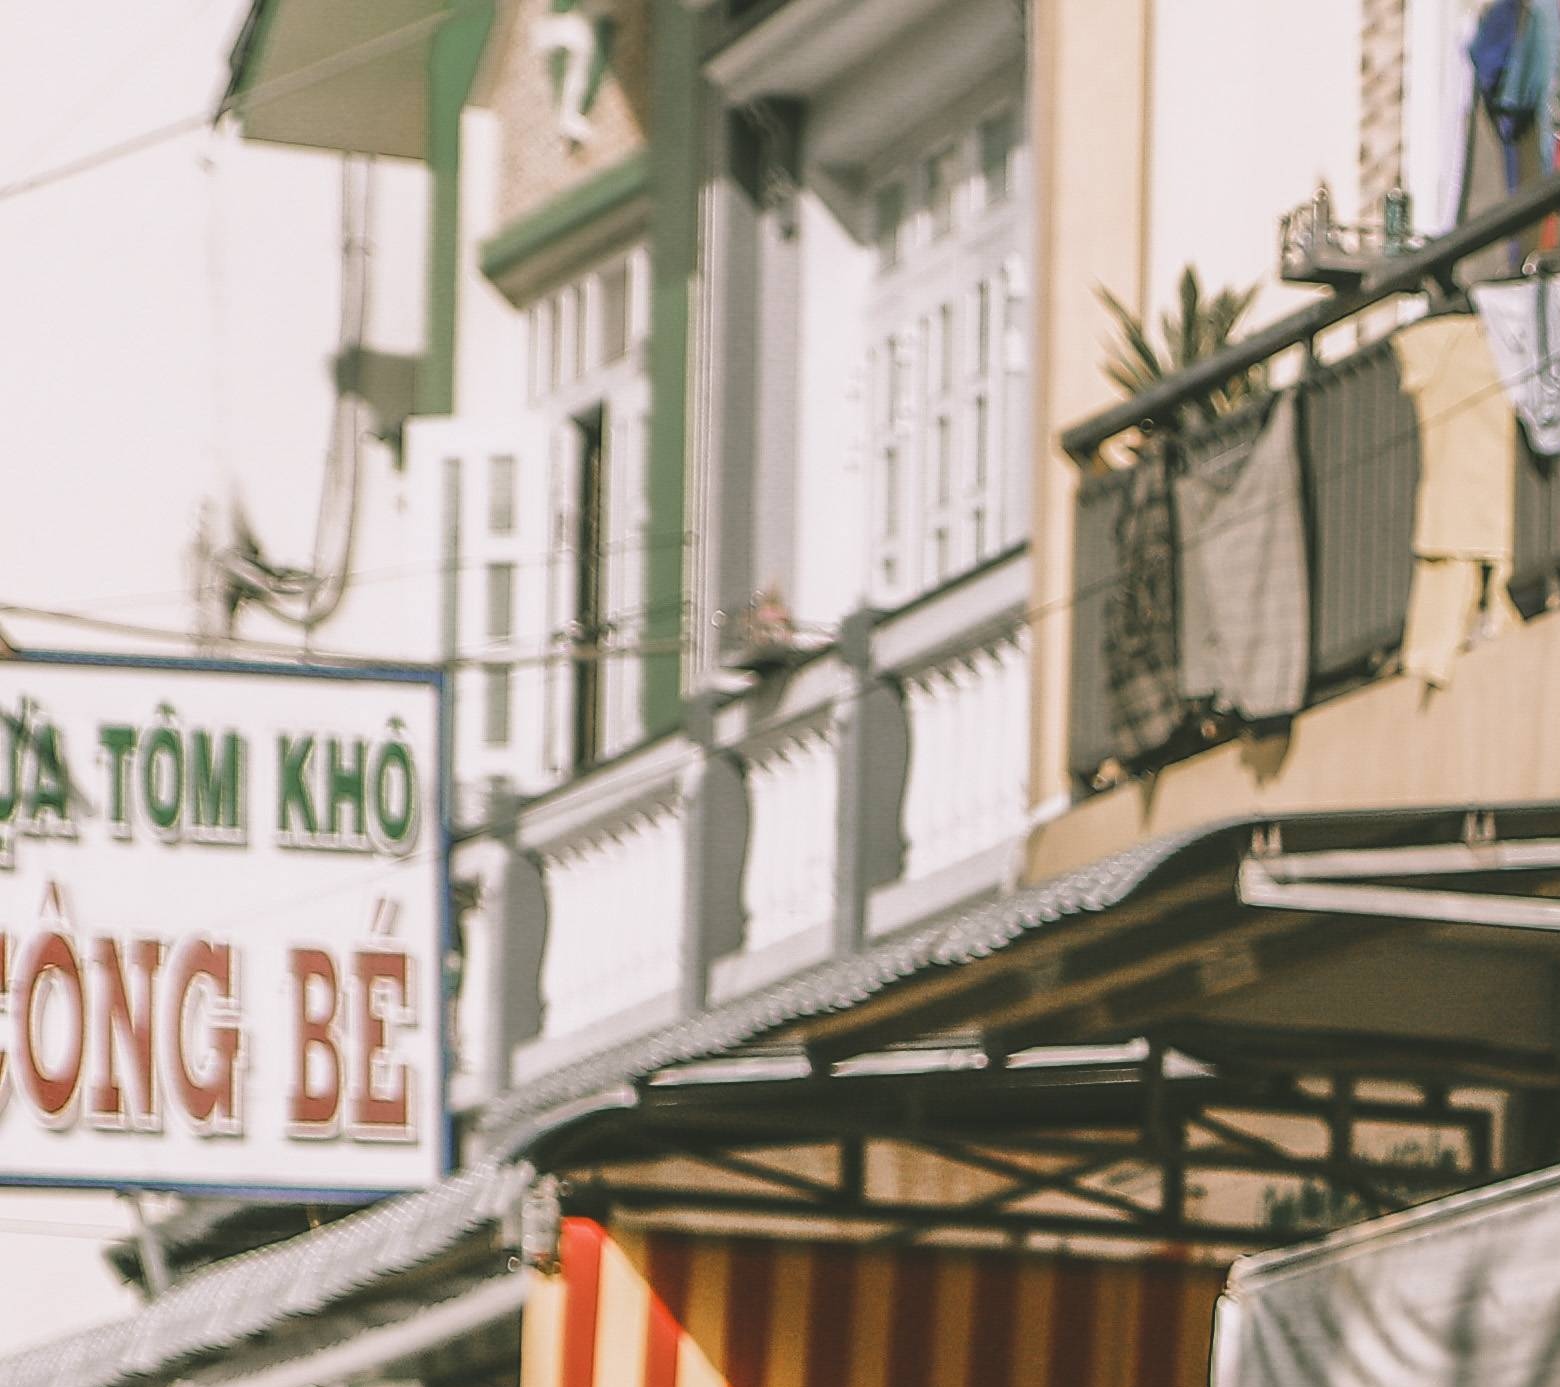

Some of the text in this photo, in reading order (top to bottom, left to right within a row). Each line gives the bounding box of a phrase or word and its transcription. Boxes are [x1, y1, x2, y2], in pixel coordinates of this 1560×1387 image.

[99, 703, 243, 840] TÔM
[278, 717, 418, 843] KHÔ
[0, 882, 413, 1132] ÔNG BÉ
